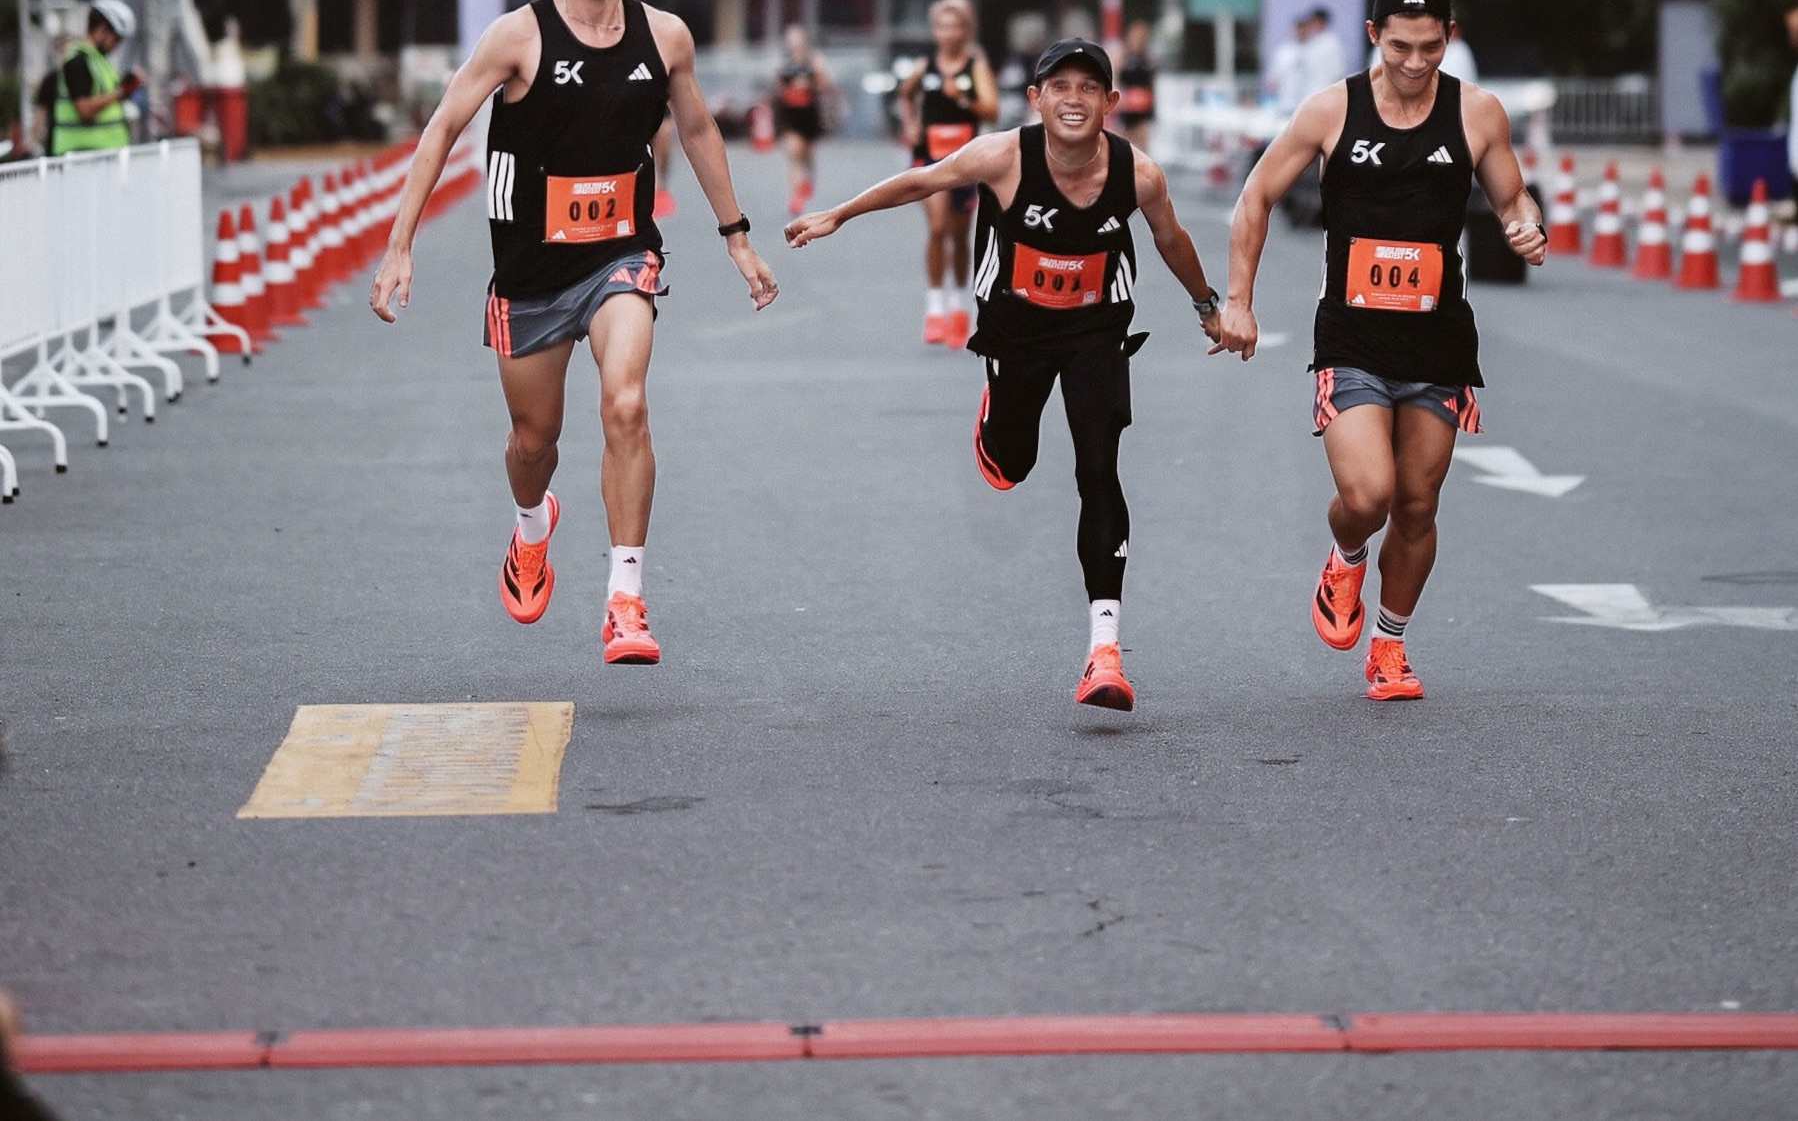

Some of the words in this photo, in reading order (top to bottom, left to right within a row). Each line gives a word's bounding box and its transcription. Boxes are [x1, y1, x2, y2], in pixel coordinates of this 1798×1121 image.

[553, 60, 585, 85] 5K
[1350, 139, 1386, 165] 5K
[569, 198, 616, 222] 002
[1023, 204, 1059, 229] 5K
[1370, 264, 1420, 288] 004
